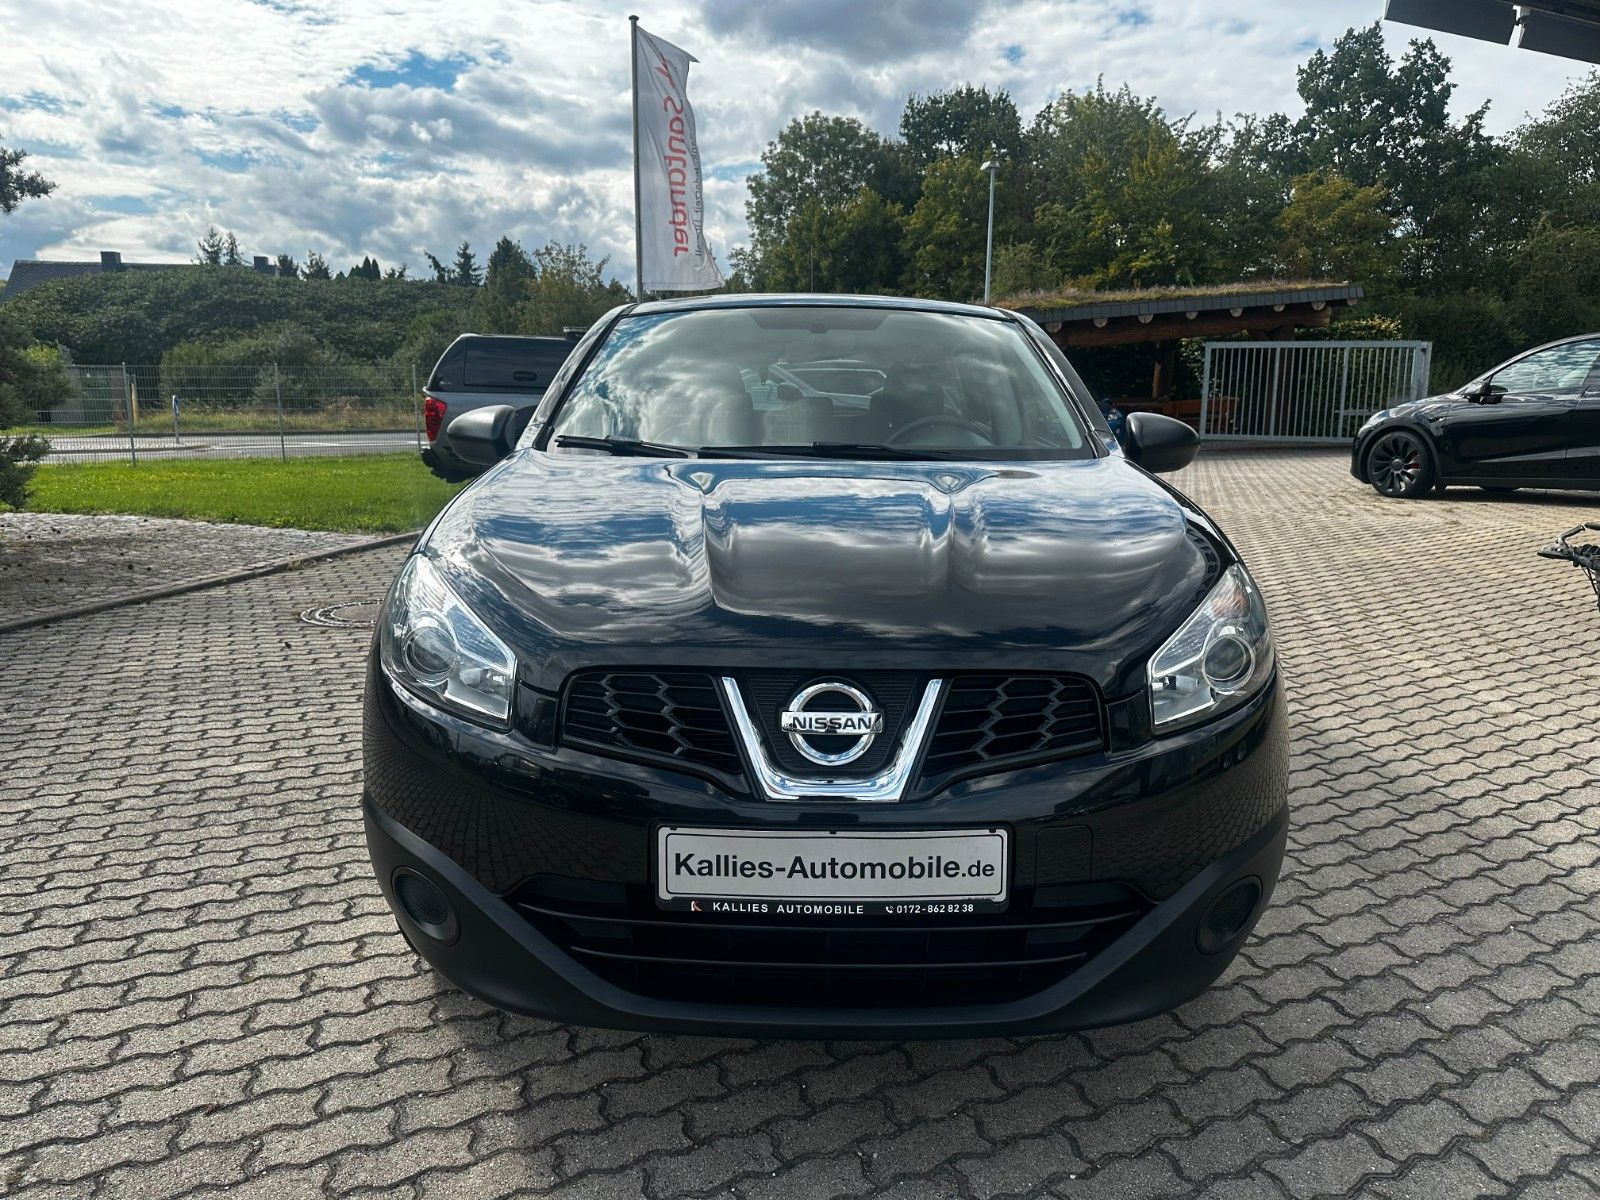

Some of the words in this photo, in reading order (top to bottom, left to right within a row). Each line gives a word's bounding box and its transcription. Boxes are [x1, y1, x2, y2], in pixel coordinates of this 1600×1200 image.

[792, 716, 871, 730] NISSAN
[674, 853, 995, 880] Kallies-Automobile.de
[712, 902, 768, 913] KALLIES
[776, 904, 864, 915] AUTOMOBILE
